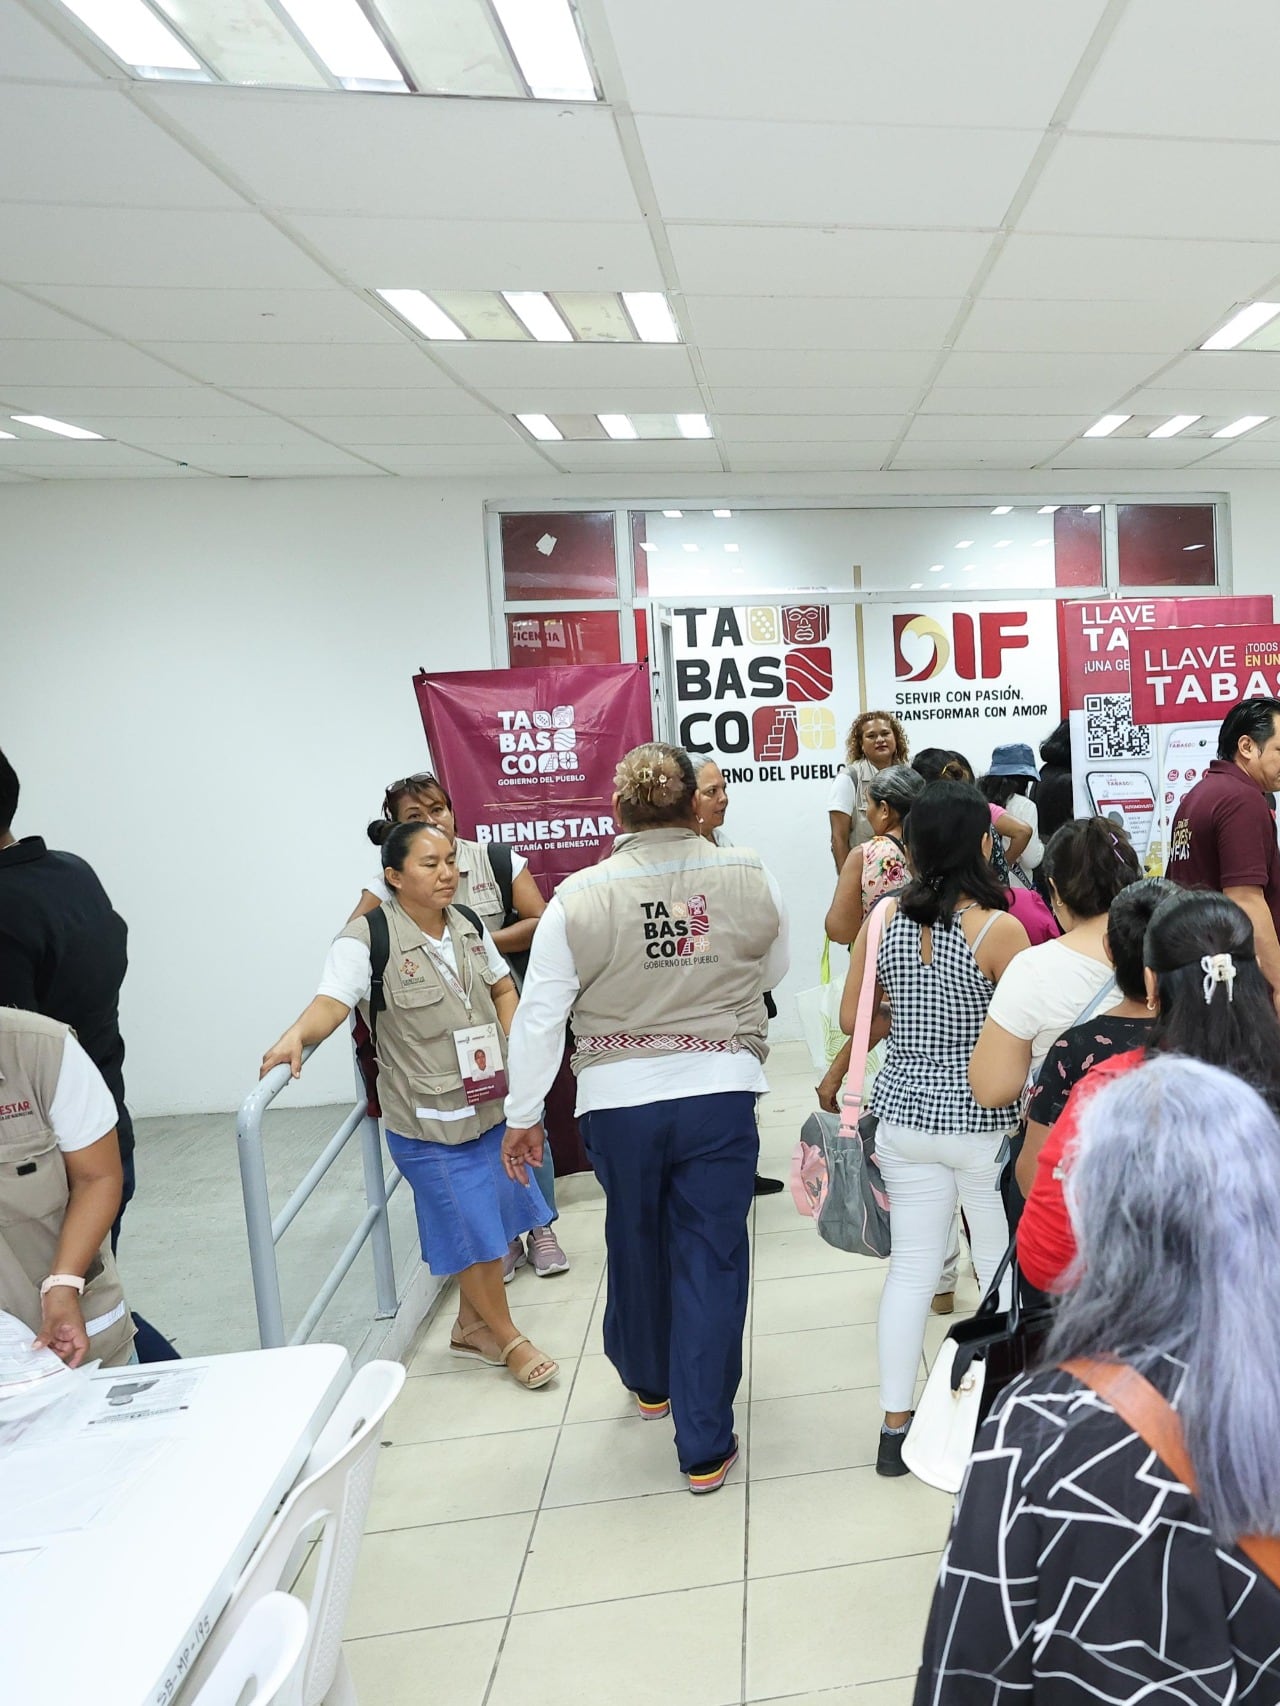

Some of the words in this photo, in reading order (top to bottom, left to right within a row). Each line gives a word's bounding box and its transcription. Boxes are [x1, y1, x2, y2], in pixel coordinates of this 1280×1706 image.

[1081, 605, 1156, 624] LLAVE
[674, 607, 743, 647] TA
[892, 611, 1029, 682] DIF
[1245, 642, 1278, 654] ¡TODOS
[1084, 660, 1112, 674] ¡UNA
[1144, 645, 1236, 672] LLAVE
[1245, 655, 1260, 667] EN
[1265, 653, 1280, 665] UN
[676, 656, 784, 701] BAS
[895, 691, 941, 705] SERVIR
[946, 690, 971, 703] CON
[976, 685, 1023, 702] PASIÓN.
[984, 706, 1006, 717] CON
[1013, 704, 1047, 717] AMOR
[497, 710, 532, 731] TA
[680, 710, 750, 754] CO
[499, 731, 551, 753] BAS
[501, 754, 537, 775] CO
[759, 766, 785, 782] DEL
[498, 778, 538, 786] GOBIERNO
[540, 776, 554, 784] DEL
[475, 816, 615, 844] BIENESTAR
[512, 841, 542, 852] ETARÍA
[544, 842, 555, 850] DE
[557, 839, 600, 849] BIENESTAR
[640, 901, 669, 919] TA
[644, 920, 688, 939] BAS
[646, 940, 676, 959] CO
[644, 959, 680, 970] GOBIERNO
[681, 957, 693, 967] DEL
[694, 955, 719, 965] PUEBLO
[0, 1101, 30, 1115] ESTAR
